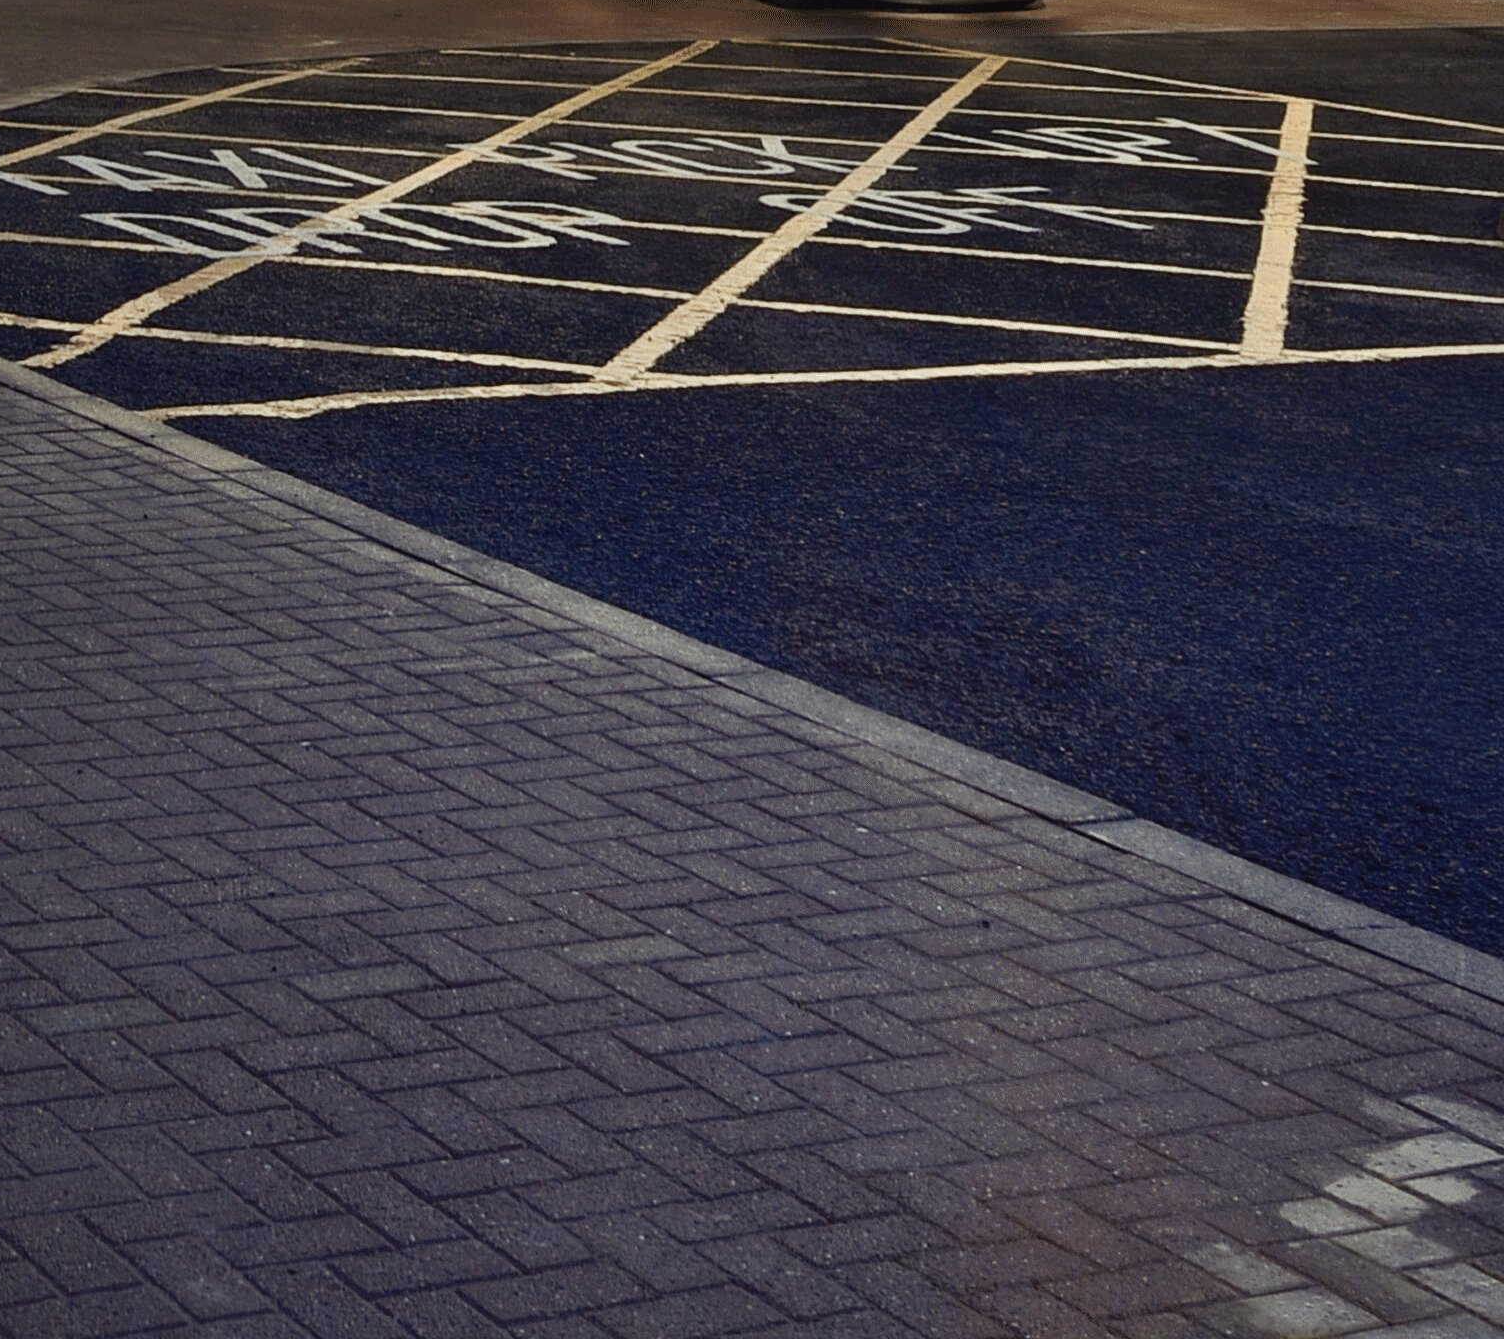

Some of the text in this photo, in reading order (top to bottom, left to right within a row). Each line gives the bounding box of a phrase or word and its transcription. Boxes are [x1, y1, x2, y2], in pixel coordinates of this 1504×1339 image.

[448, 134, 919, 181] PICK
[80, 186, 1154, 259] DROP OFF
